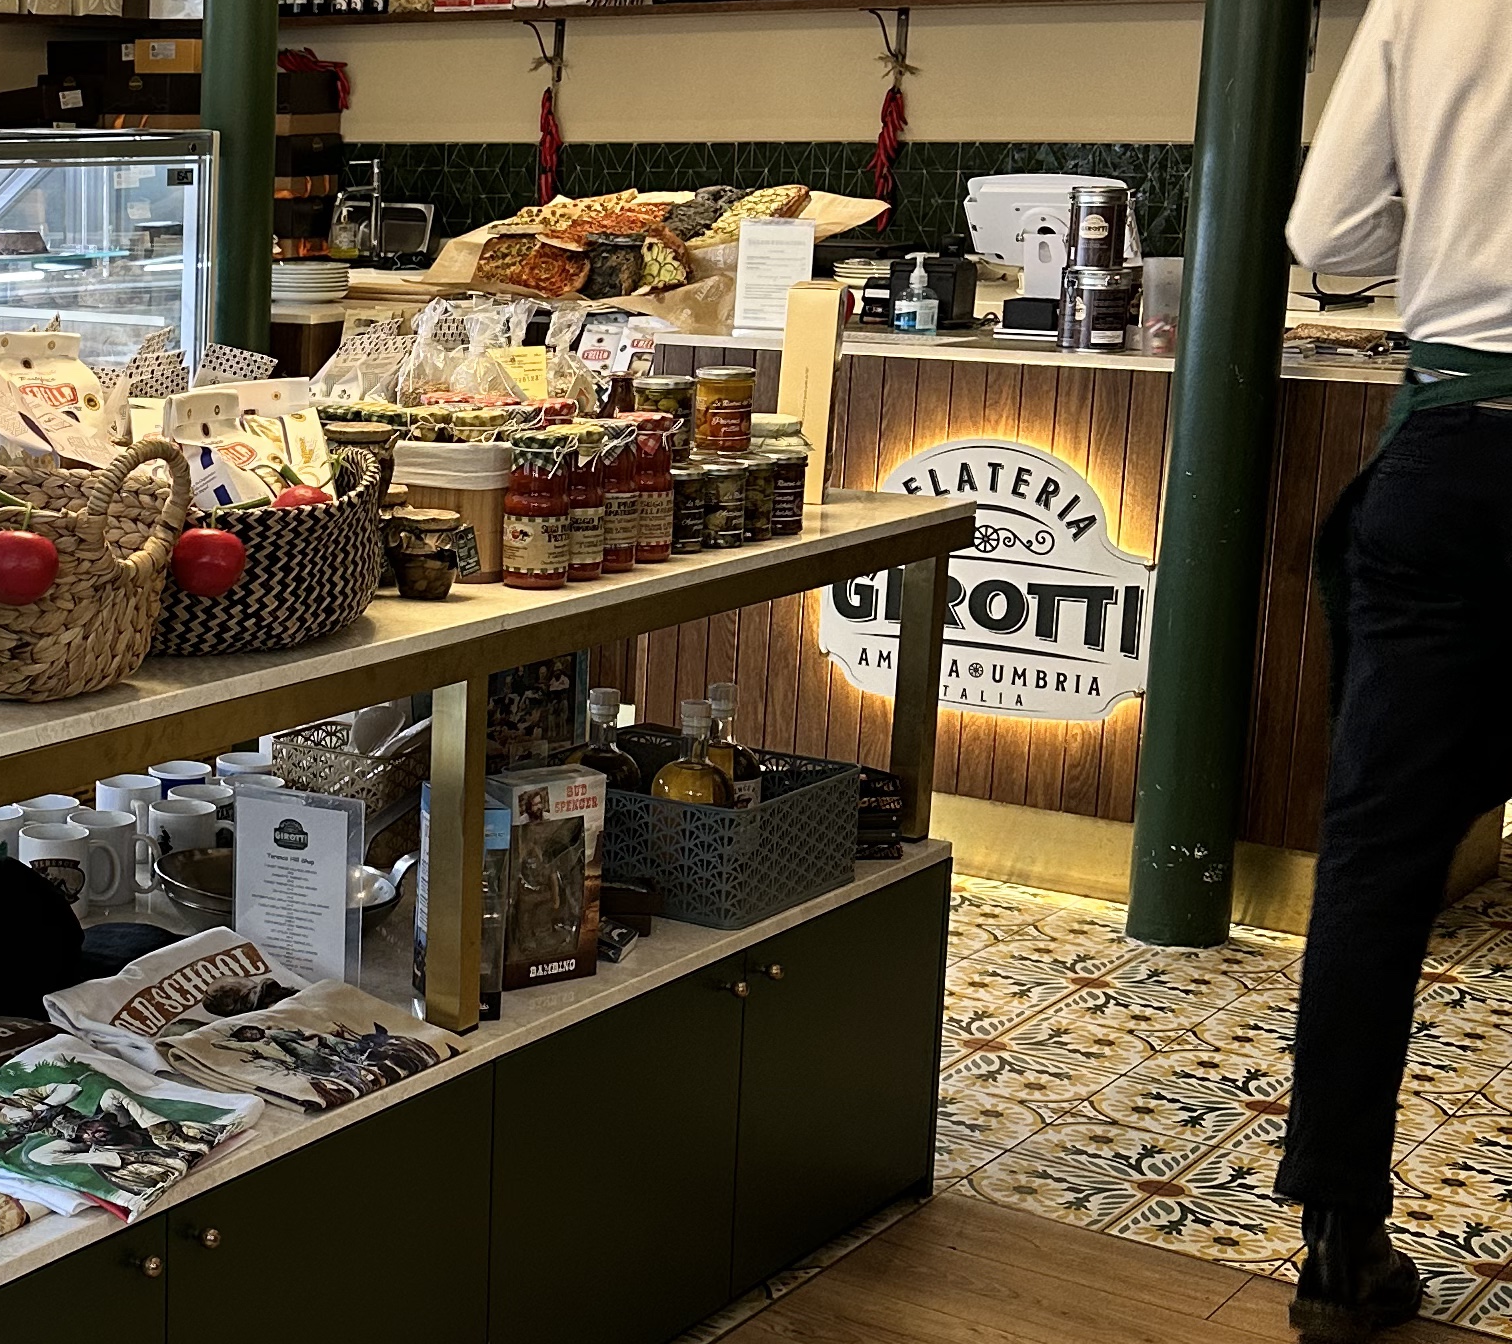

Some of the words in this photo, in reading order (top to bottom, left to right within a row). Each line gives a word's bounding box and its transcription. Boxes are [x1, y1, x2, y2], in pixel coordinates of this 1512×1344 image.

[902, 462, 1098, 543] ELATERIA
[858, 647, 961, 679] AMA
[991, 663, 1102, 697] UMBRIA
[942, 685, 1024, 707] TALIA
[566, 783, 588, 798] BUD
[554, 795, 599, 814] SPENCER
[274, 831, 308, 843] GIROTTI
[529, 958, 576, 978] BAMBINO
[150, 947, 266, 1014] SCHOOL
